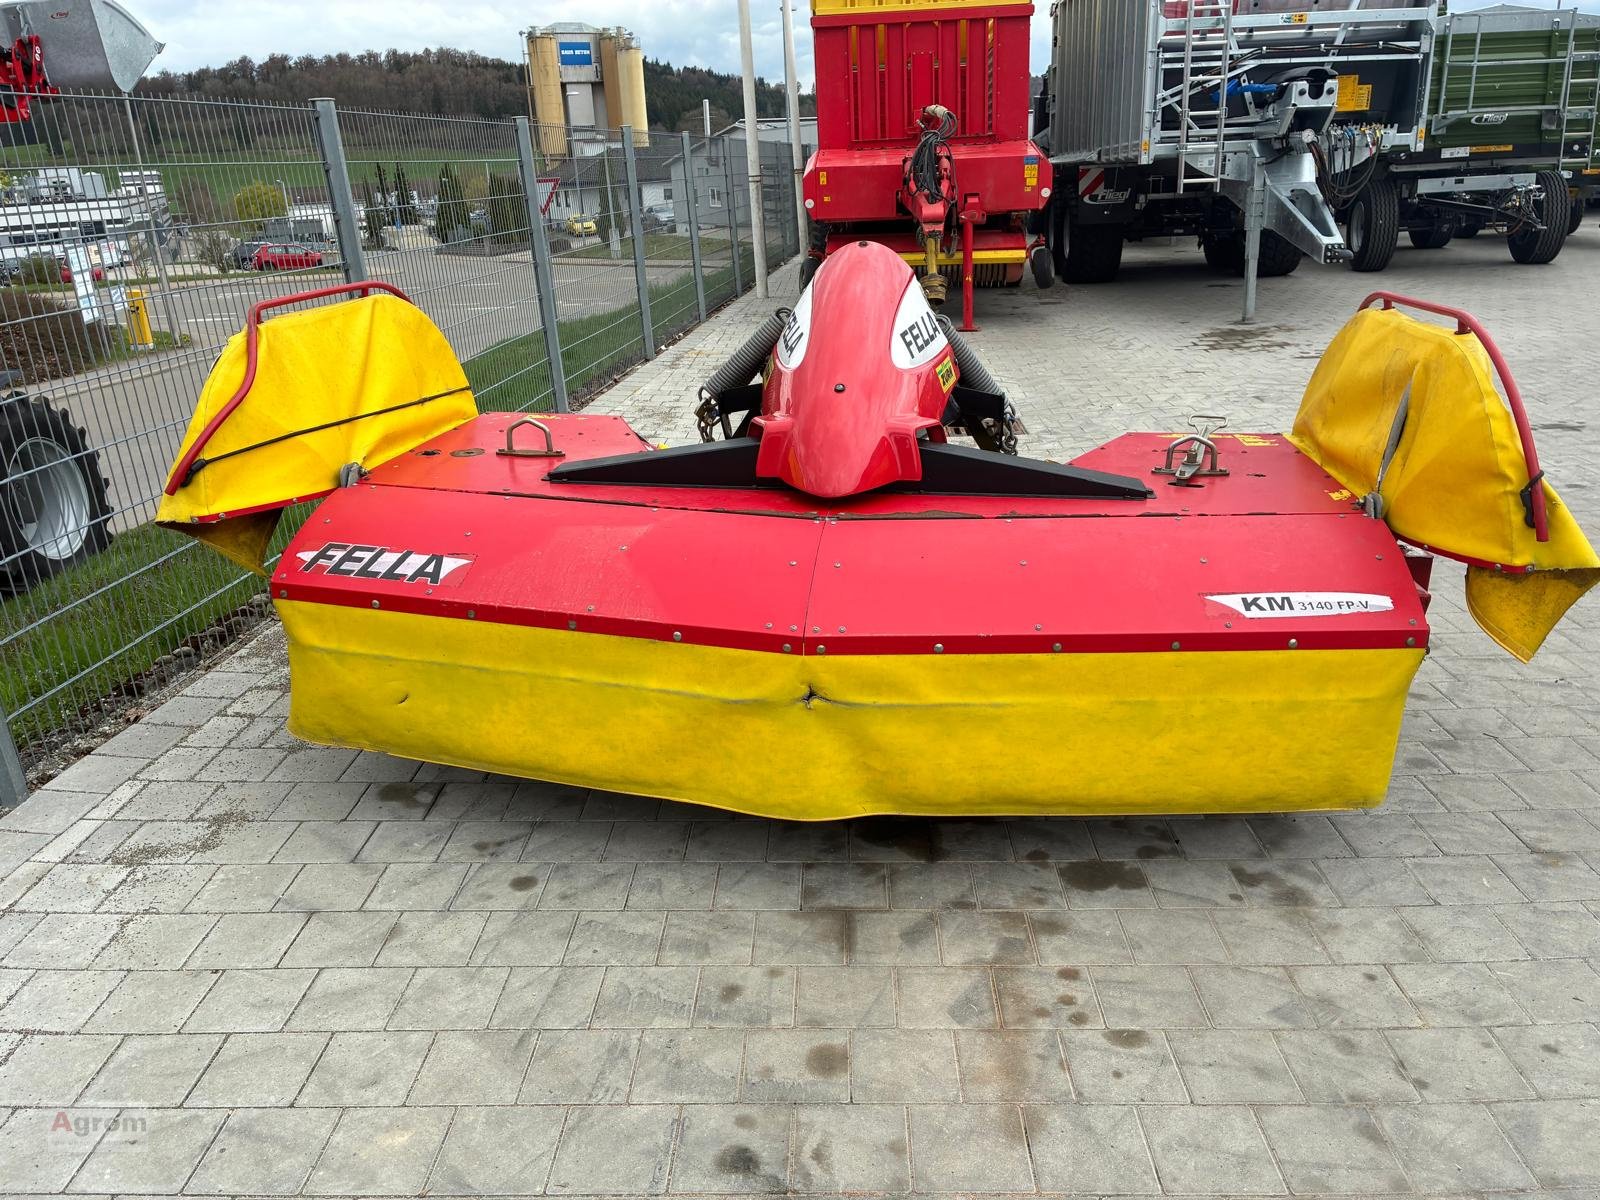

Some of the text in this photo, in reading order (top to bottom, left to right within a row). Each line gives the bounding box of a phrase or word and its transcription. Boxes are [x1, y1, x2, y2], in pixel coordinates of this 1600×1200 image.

[900, 310, 941, 360] FELLA
[299, 541, 445, 586] FELLA
[1240, 596, 1369, 612] KM 3140 FP-V
